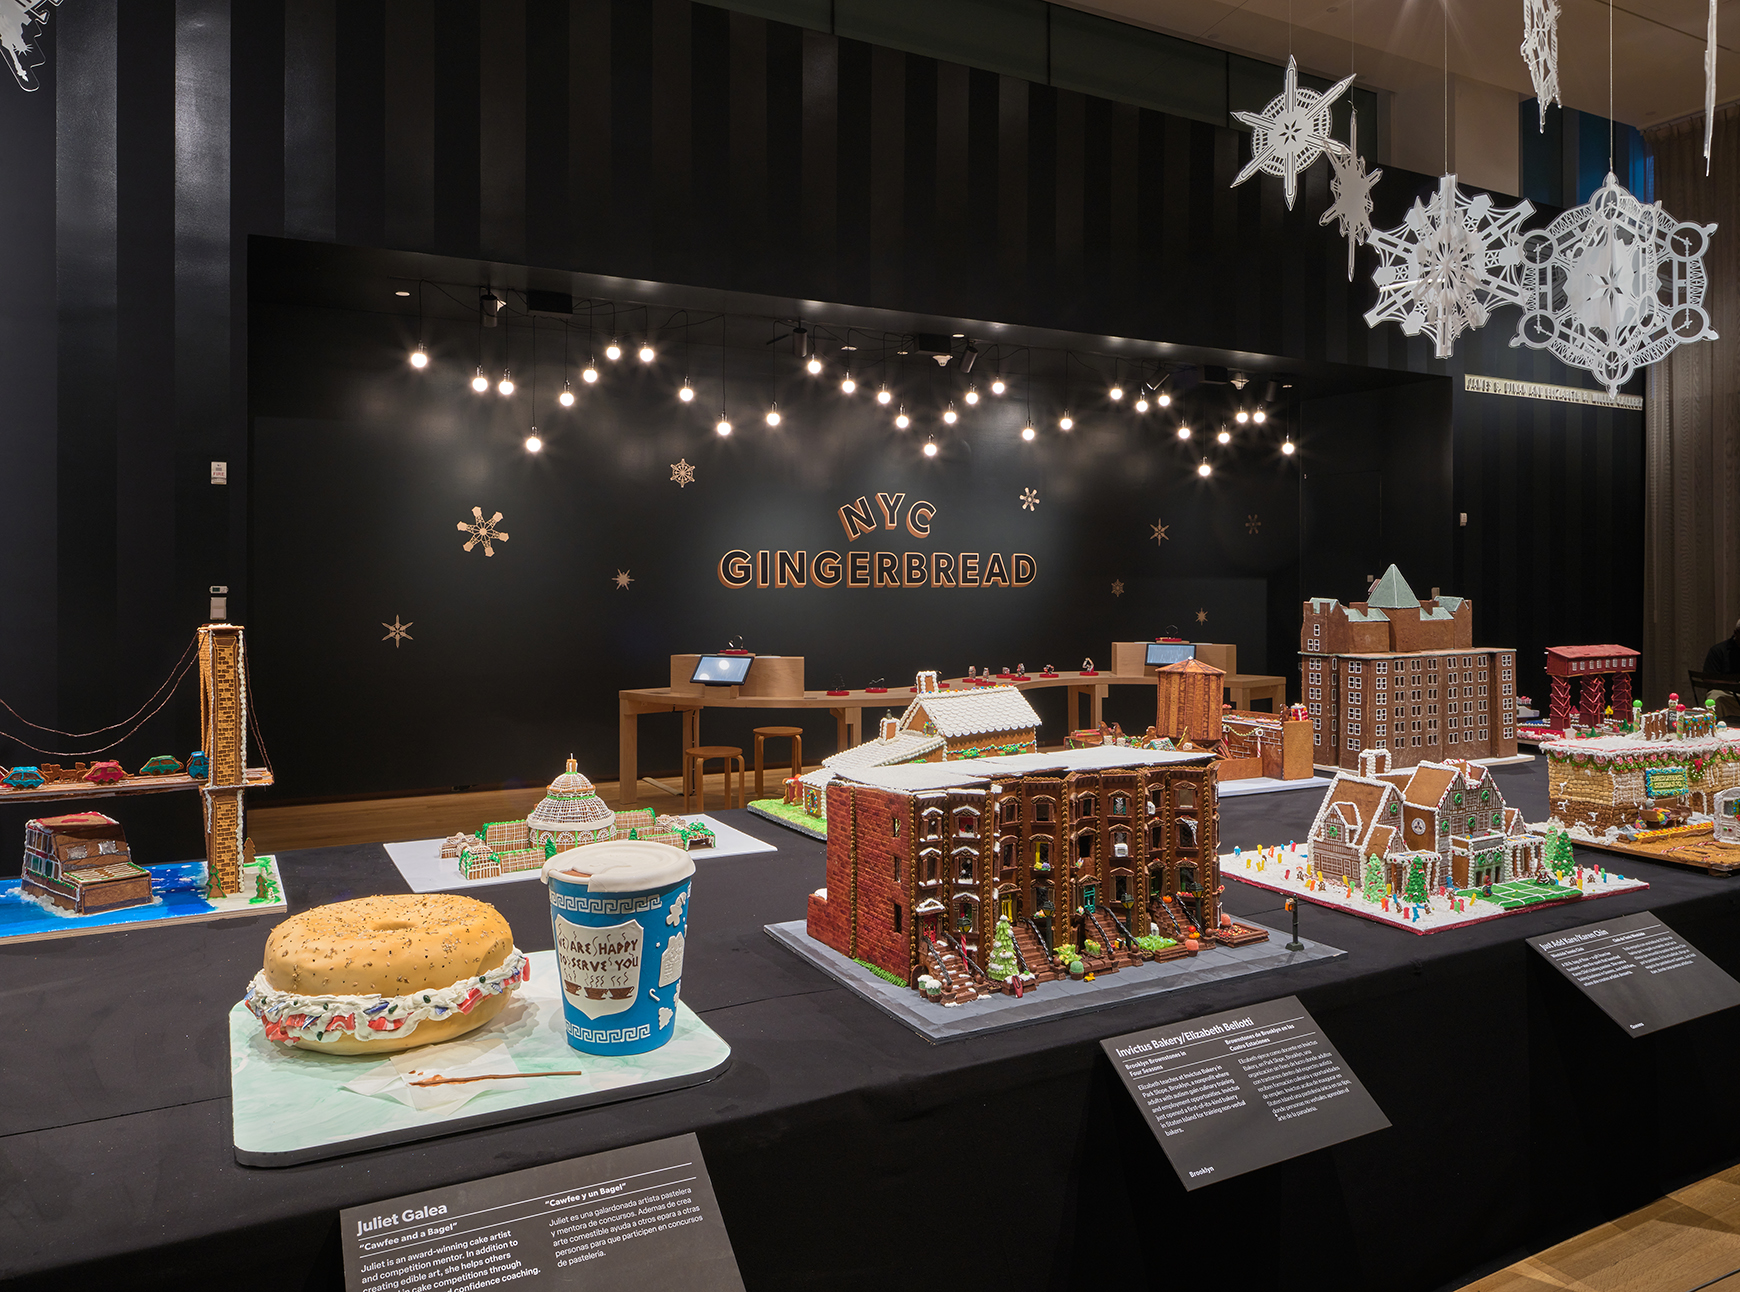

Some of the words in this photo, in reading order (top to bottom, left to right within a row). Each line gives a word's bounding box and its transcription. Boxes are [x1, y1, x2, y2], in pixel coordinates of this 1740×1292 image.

[1467, 378, 1492, 391] JAMES
[1504, 382, 1527, 395] DINAN
[1529, 386, 1544, 397] AND
[838, 492, 937, 542] NYC
[718, 549, 1037, 588] GINGERBREAD
[570, 940, 592, 955] ARE
[598, 939, 639, 955] HAPPY
[571, 957, 607, 972] SERVE
[615, 956, 639, 971] YOU
[1115, 1043, 1153, 1057] Invictus
[1151, 1025, 1225, 1049] Bakery/Elizabeth
[1222, 1017, 1254, 1031] Bellotti
[1125, 1061, 1149, 1070] Brooklyn
[1148, 1053, 1181, 1064] Brownstones
[1141, 1065, 1163, 1074] Seasons
[1189, 1166, 1214, 1178] Brooklyn
[357, 1214, 399, 1237] Juliet
[402, 1205, 447, 1222] Galea
[361, 1261, 385, 1273] Juliet
[408, 1242, 468, 1261] award-winning
[469, 1236, 488, 1246] cake
[490, 1230, 511, 1241] artist
[362, 1273, 378, 1284] and
[379, 1261, 431, 1279] competition
[433, 1253, 465, 1266] mentor.
[475, 1242, 508, 1255] addition
[363, 1281, 399, 1292] creating
[400, 1273, 426, 1285] edible
[428, 1269, 443, 1278] art,
[444, 1266, 460, 1274] she
[461, 1260, 484, 1270] helps
[484, 1253, 511, 1264] others
[412, 1284, 432, 1292] cake
[433, 1269, 488, 1288] competitions
[489, 1260, 522, 1274] through
[454, 1277, 500, 1292] confidence
[501, 1268, 541, 1282] coaching.
